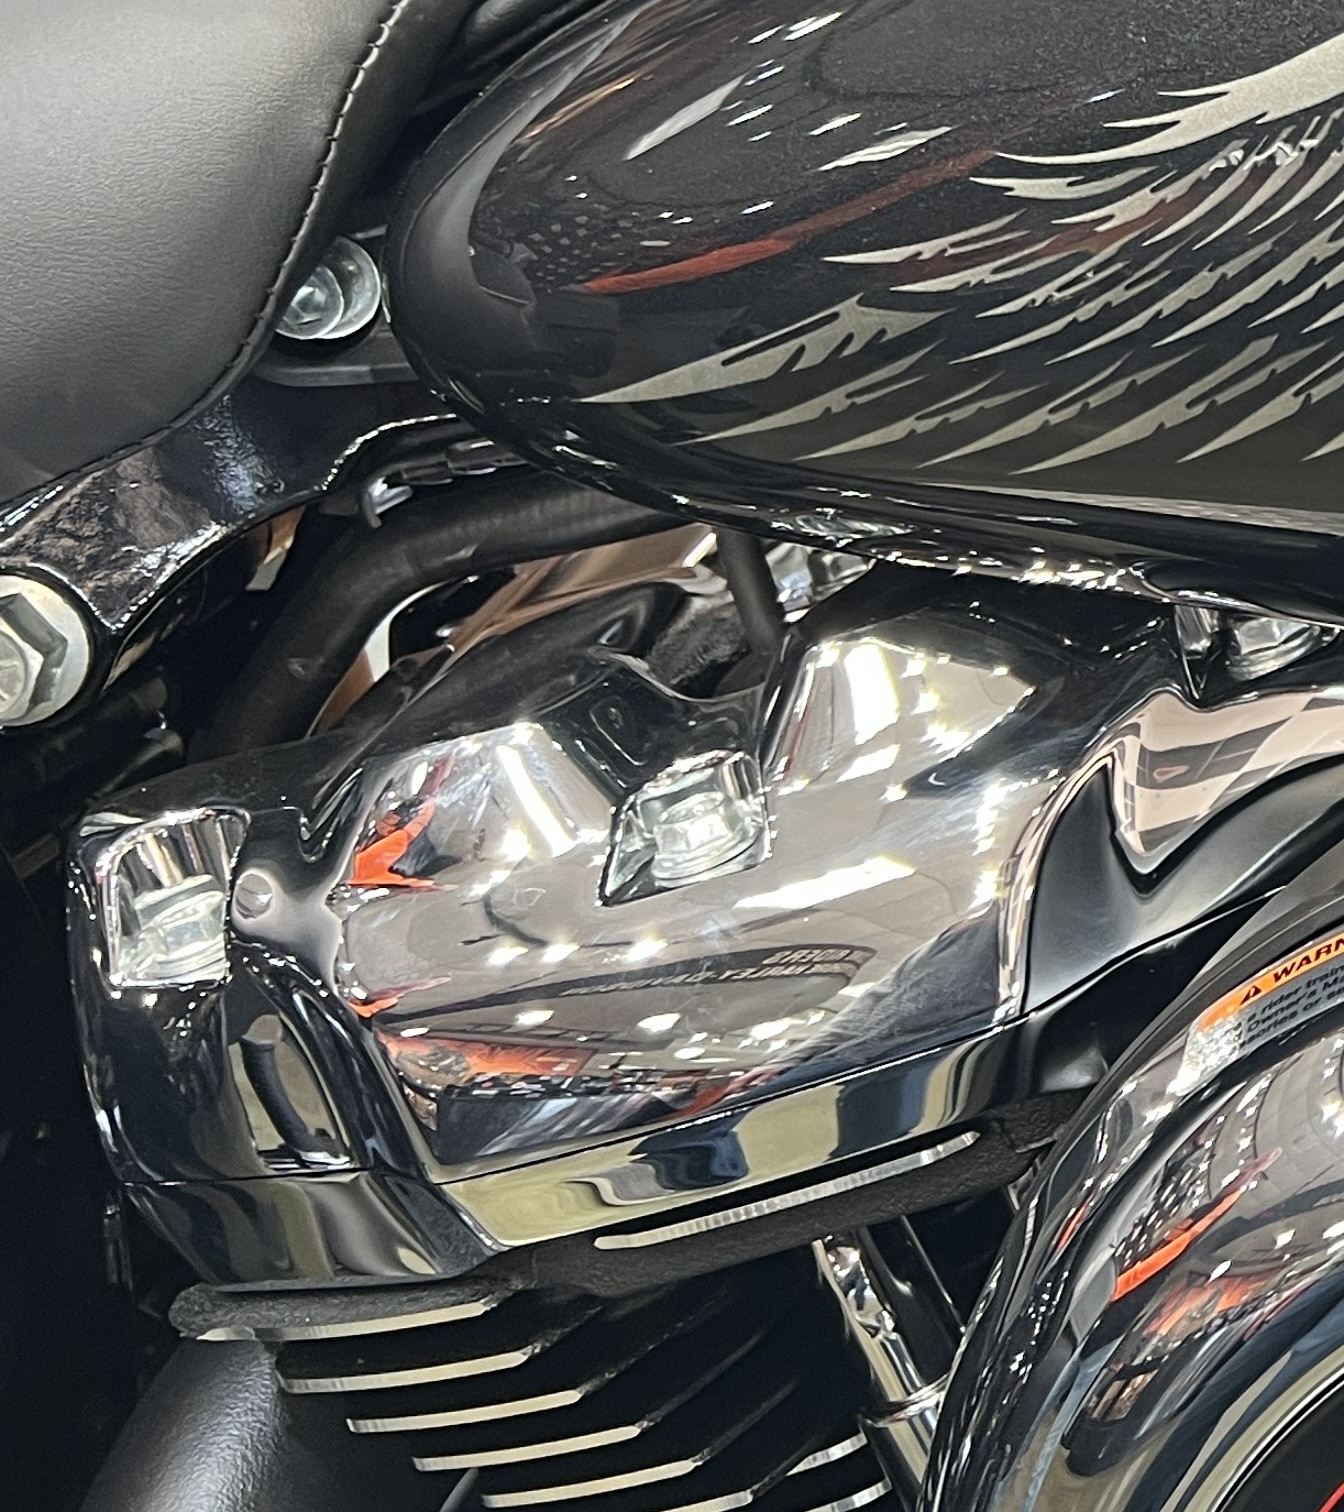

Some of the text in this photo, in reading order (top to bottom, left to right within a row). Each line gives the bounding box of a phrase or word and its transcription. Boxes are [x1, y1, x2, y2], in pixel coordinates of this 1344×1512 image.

[1246, 988, 1318, 1033] Owner's
[1260, 985, 1303, 1015] rider
[1301, 996, 1323, 1013] or
